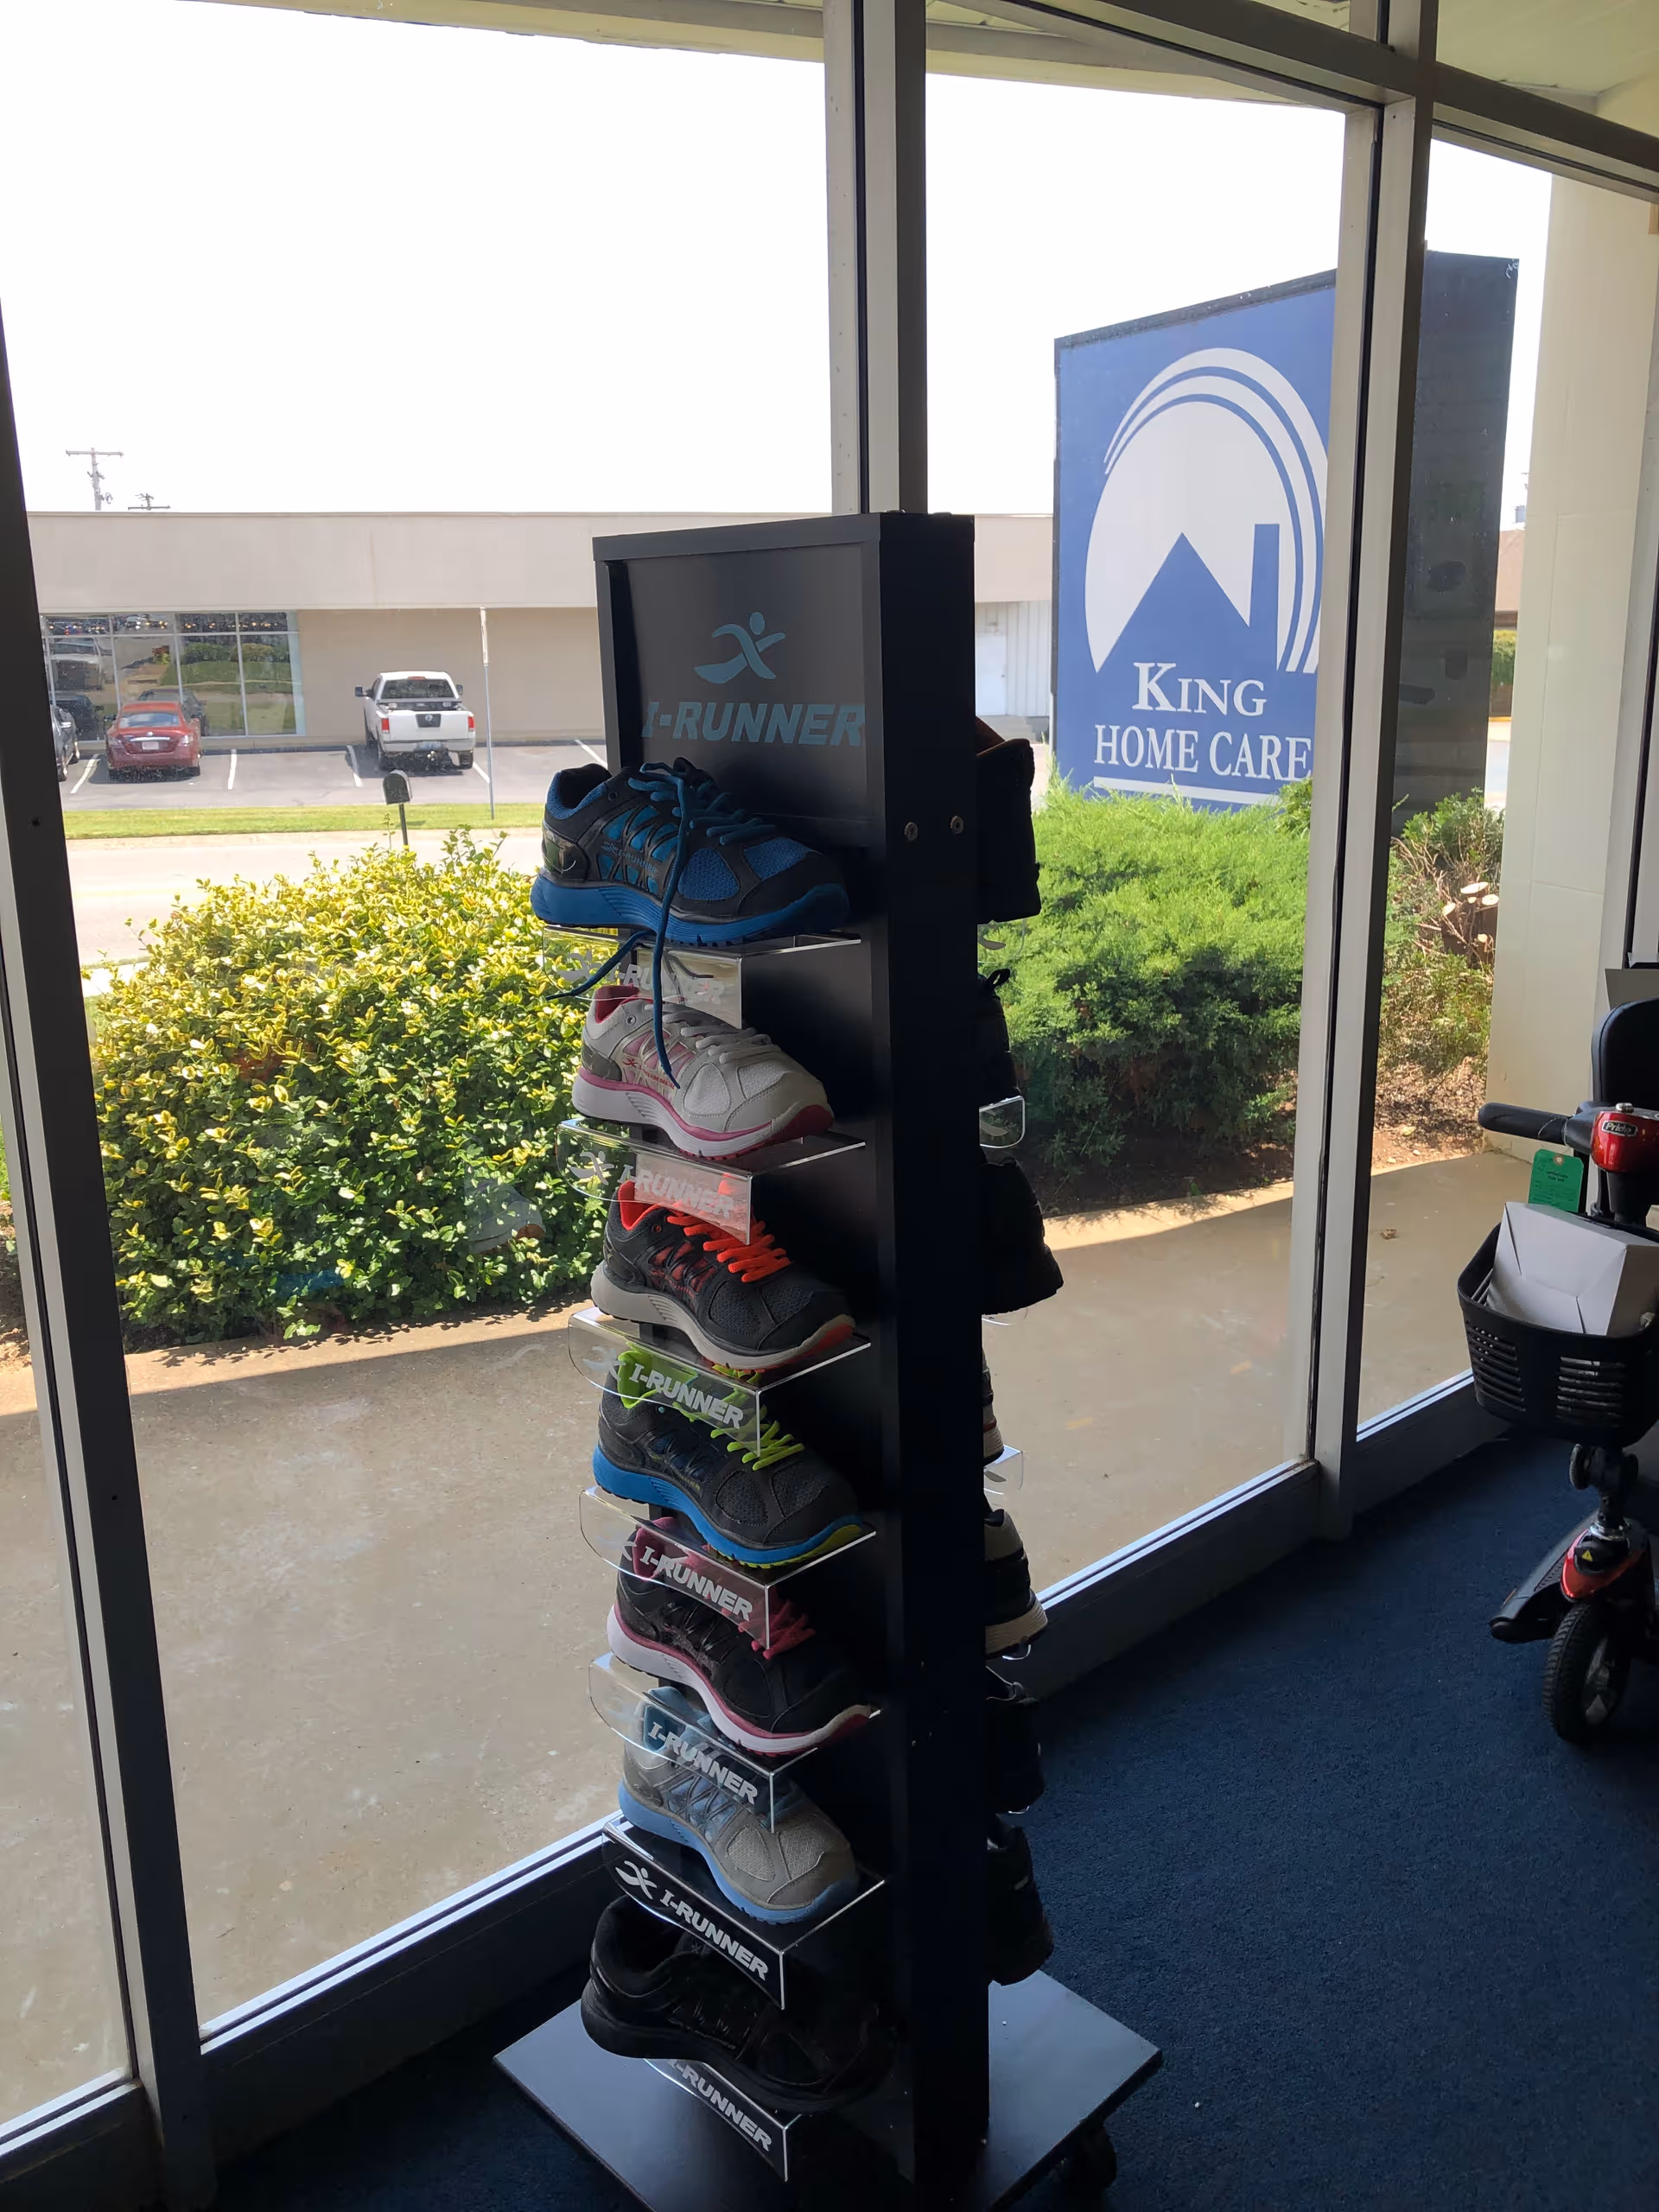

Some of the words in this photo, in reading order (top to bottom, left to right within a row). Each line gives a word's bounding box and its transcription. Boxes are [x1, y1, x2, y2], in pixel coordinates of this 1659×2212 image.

[641, 701, 865, 747] I-RUNNER
[1094, 724, 1198, 772] HOME
[1210, 731, 1312, 782] CARE
[617, 1164, 734, 1219] I-RUNNER
[629, 1363, 744, 1430] I-RUNNER
[639, 1545, 753, 1622] I-RUNNER
[648, 1721, 759, 1805] I-RUNNER
[659, 1889, 769, 1981] I-RUNNER
